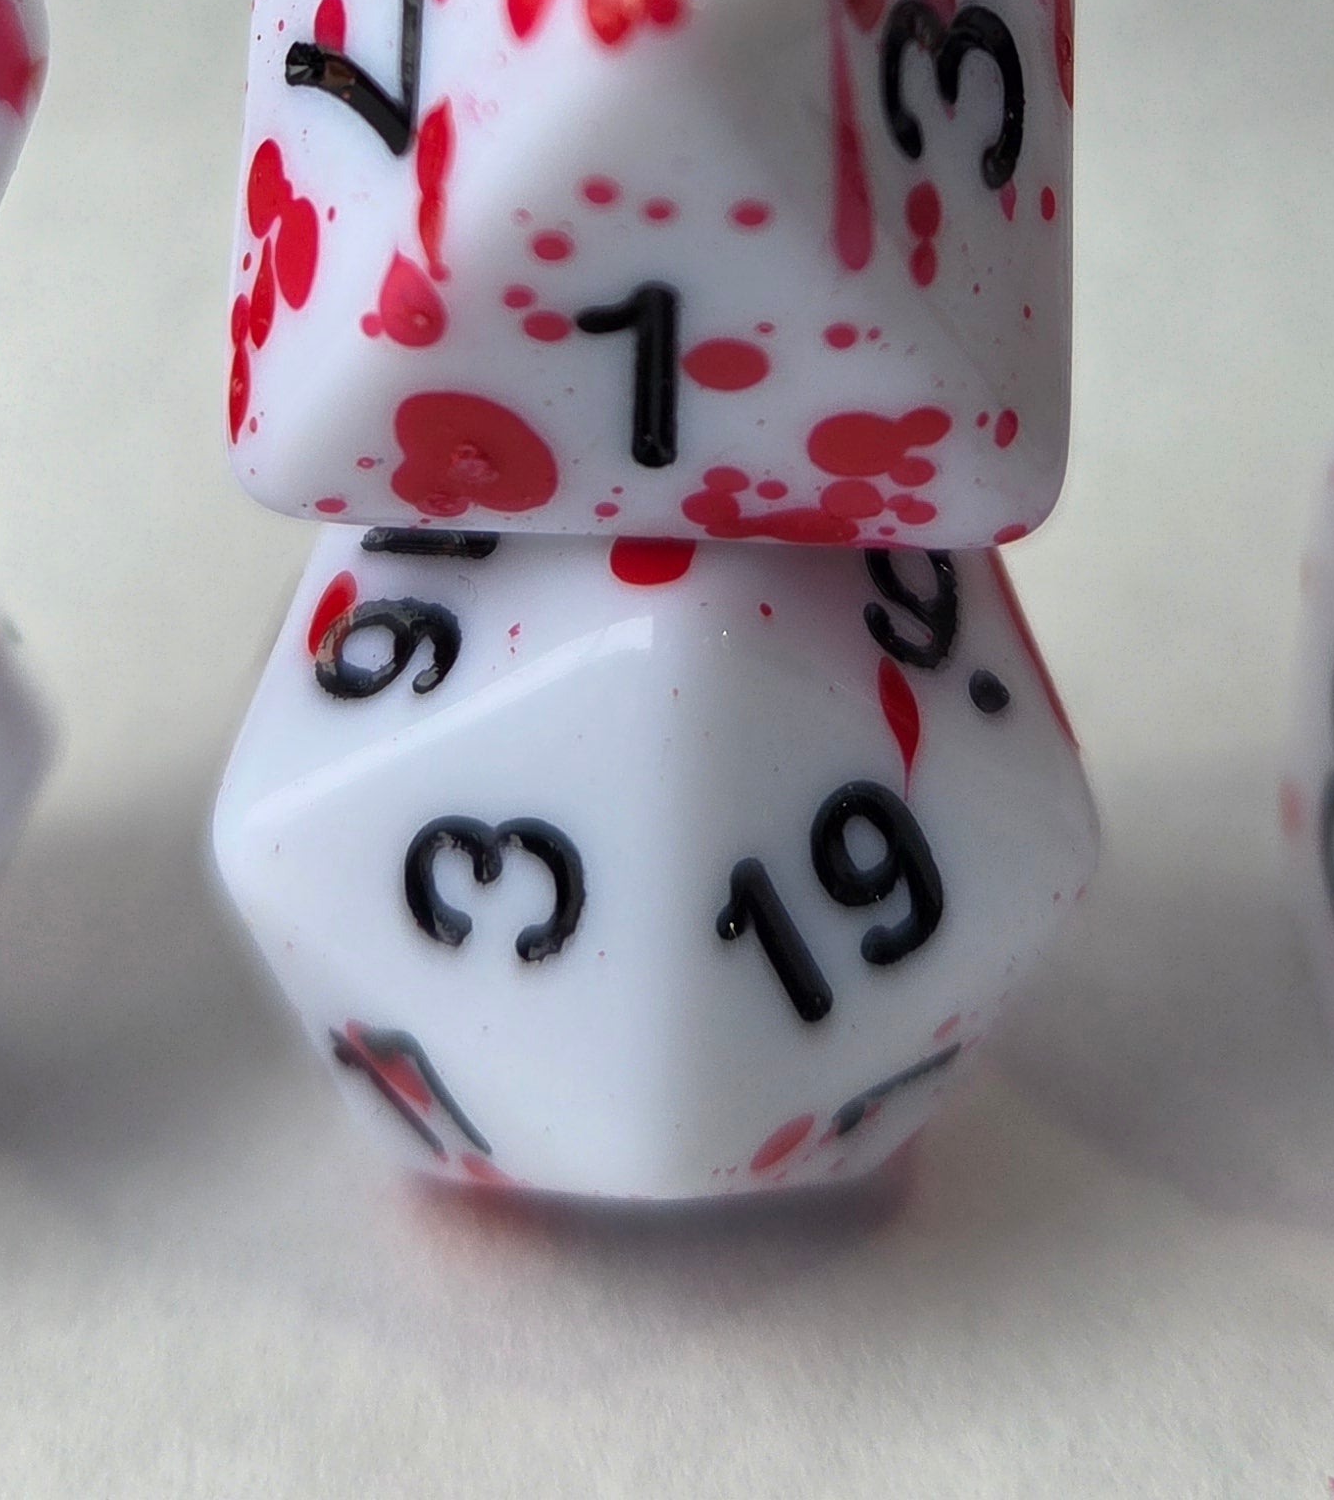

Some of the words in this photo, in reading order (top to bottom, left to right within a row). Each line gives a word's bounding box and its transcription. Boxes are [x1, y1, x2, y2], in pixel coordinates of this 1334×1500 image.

[575, 282, 681, 468] 1
[403, 814, 587, 964] 3
[715, 780, 943, 1024] 19
